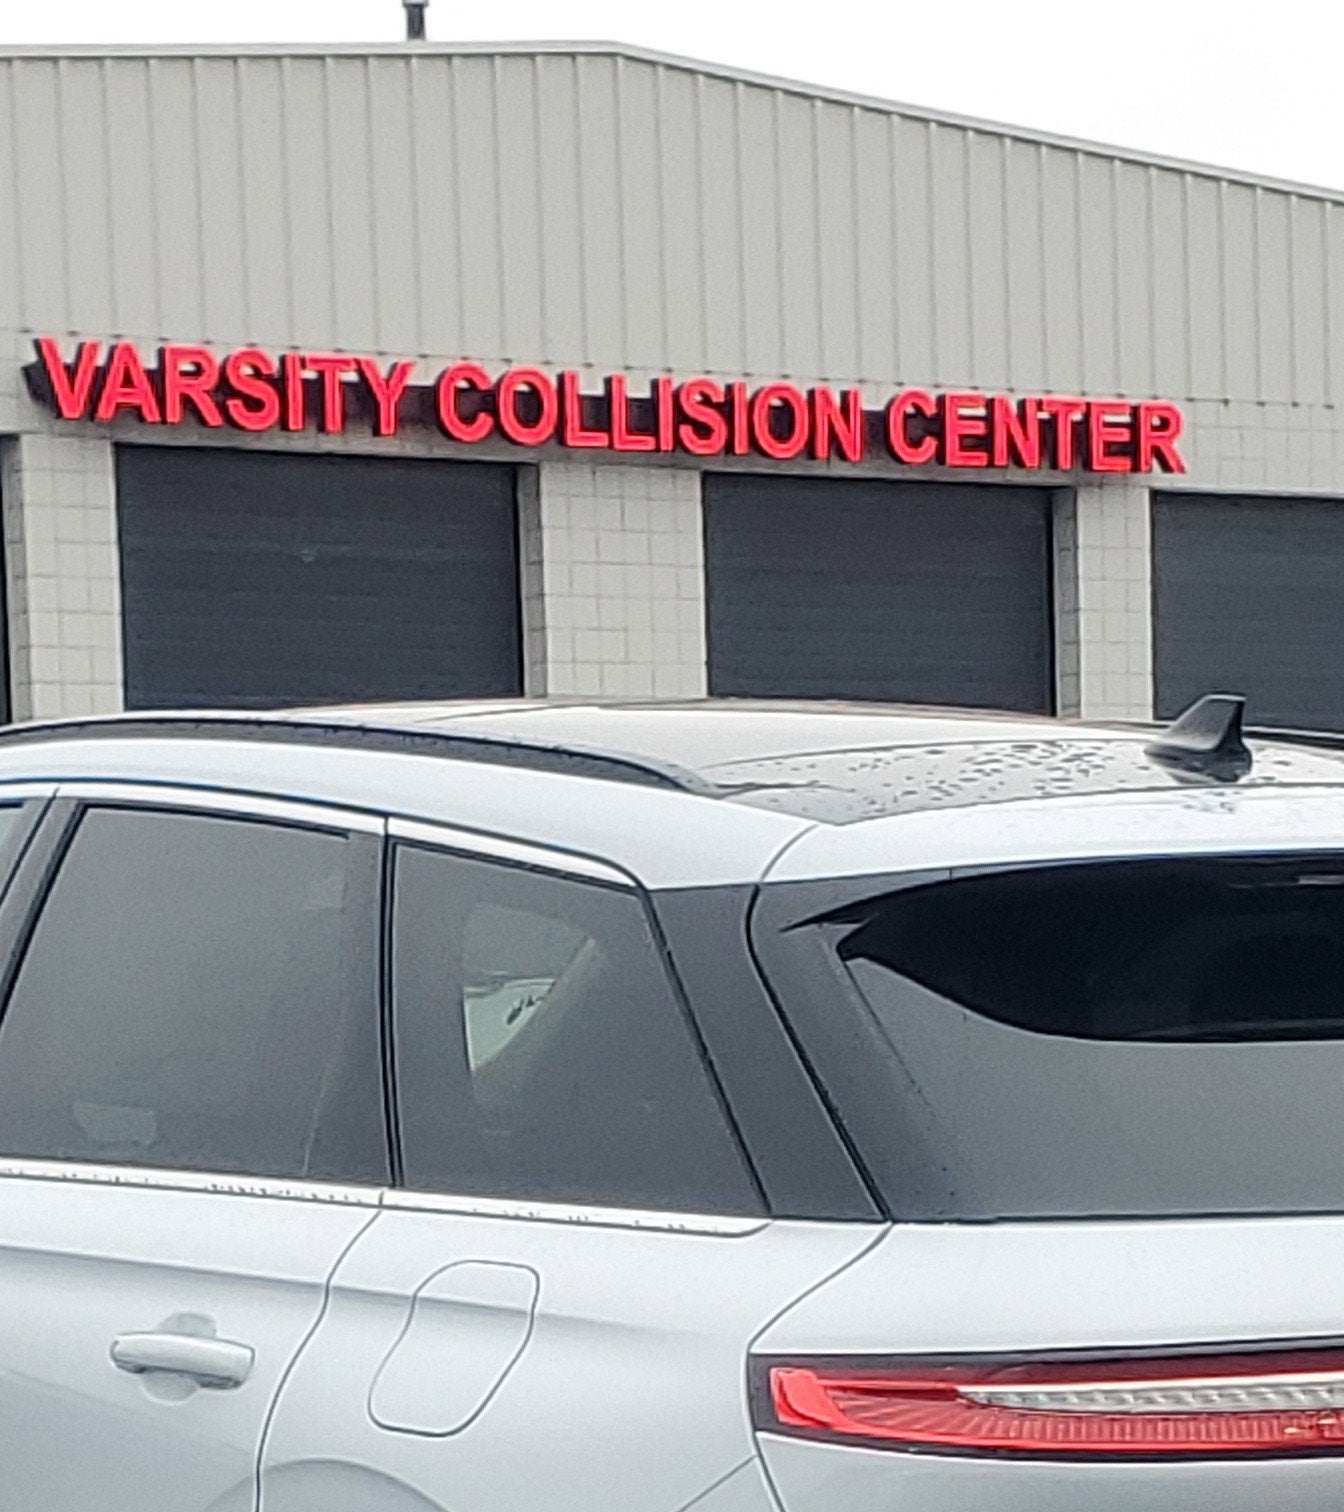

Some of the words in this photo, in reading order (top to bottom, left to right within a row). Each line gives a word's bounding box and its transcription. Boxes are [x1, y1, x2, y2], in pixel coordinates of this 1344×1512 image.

[36, 336, 415, 437] VARSITY
[436, 360, 864, 462] COLLISION
[887, 388, 1186, 474] CENTER
